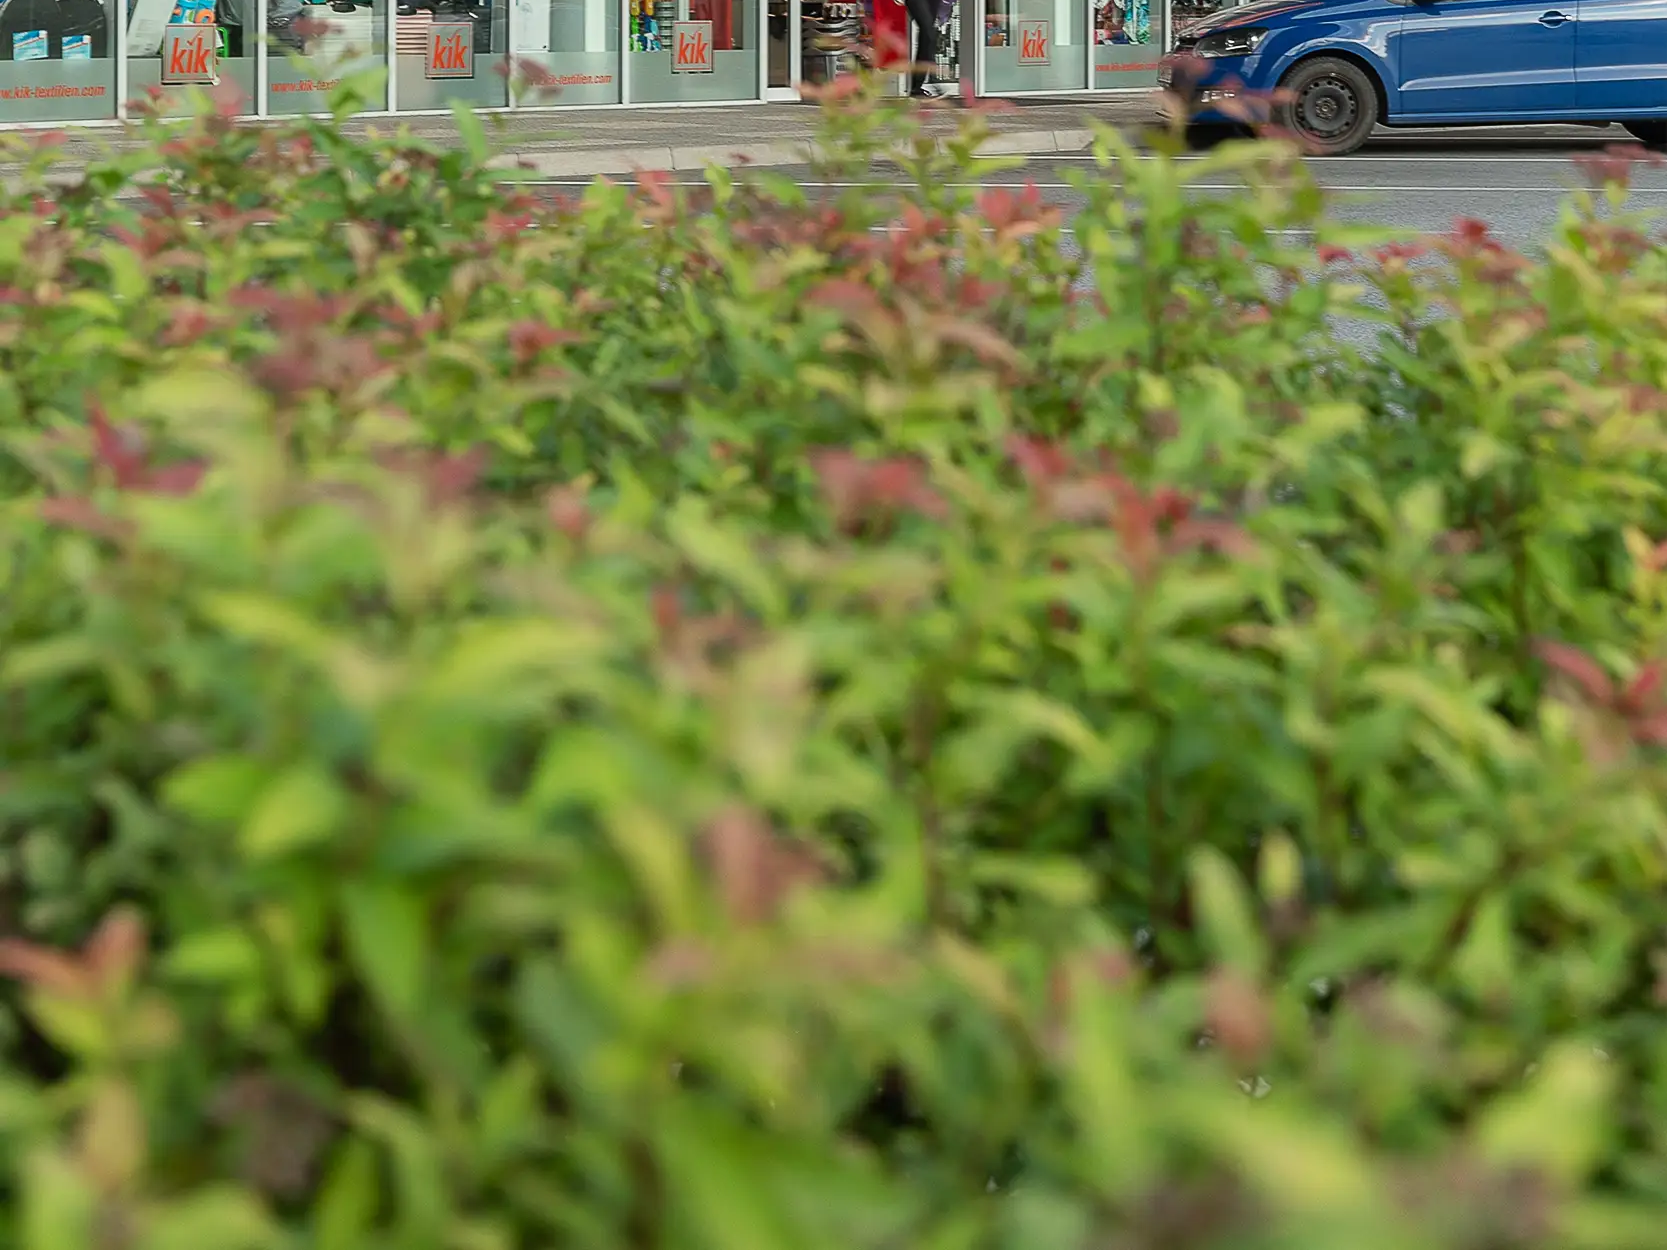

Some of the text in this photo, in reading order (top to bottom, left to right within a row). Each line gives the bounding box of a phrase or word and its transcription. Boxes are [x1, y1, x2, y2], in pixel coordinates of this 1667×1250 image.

[170, 31, 211, 74] kik
[432, 28, 468, 69] kik
[677, 29, 709, 65] kik
[1022, 25, 1048, 58] kik
